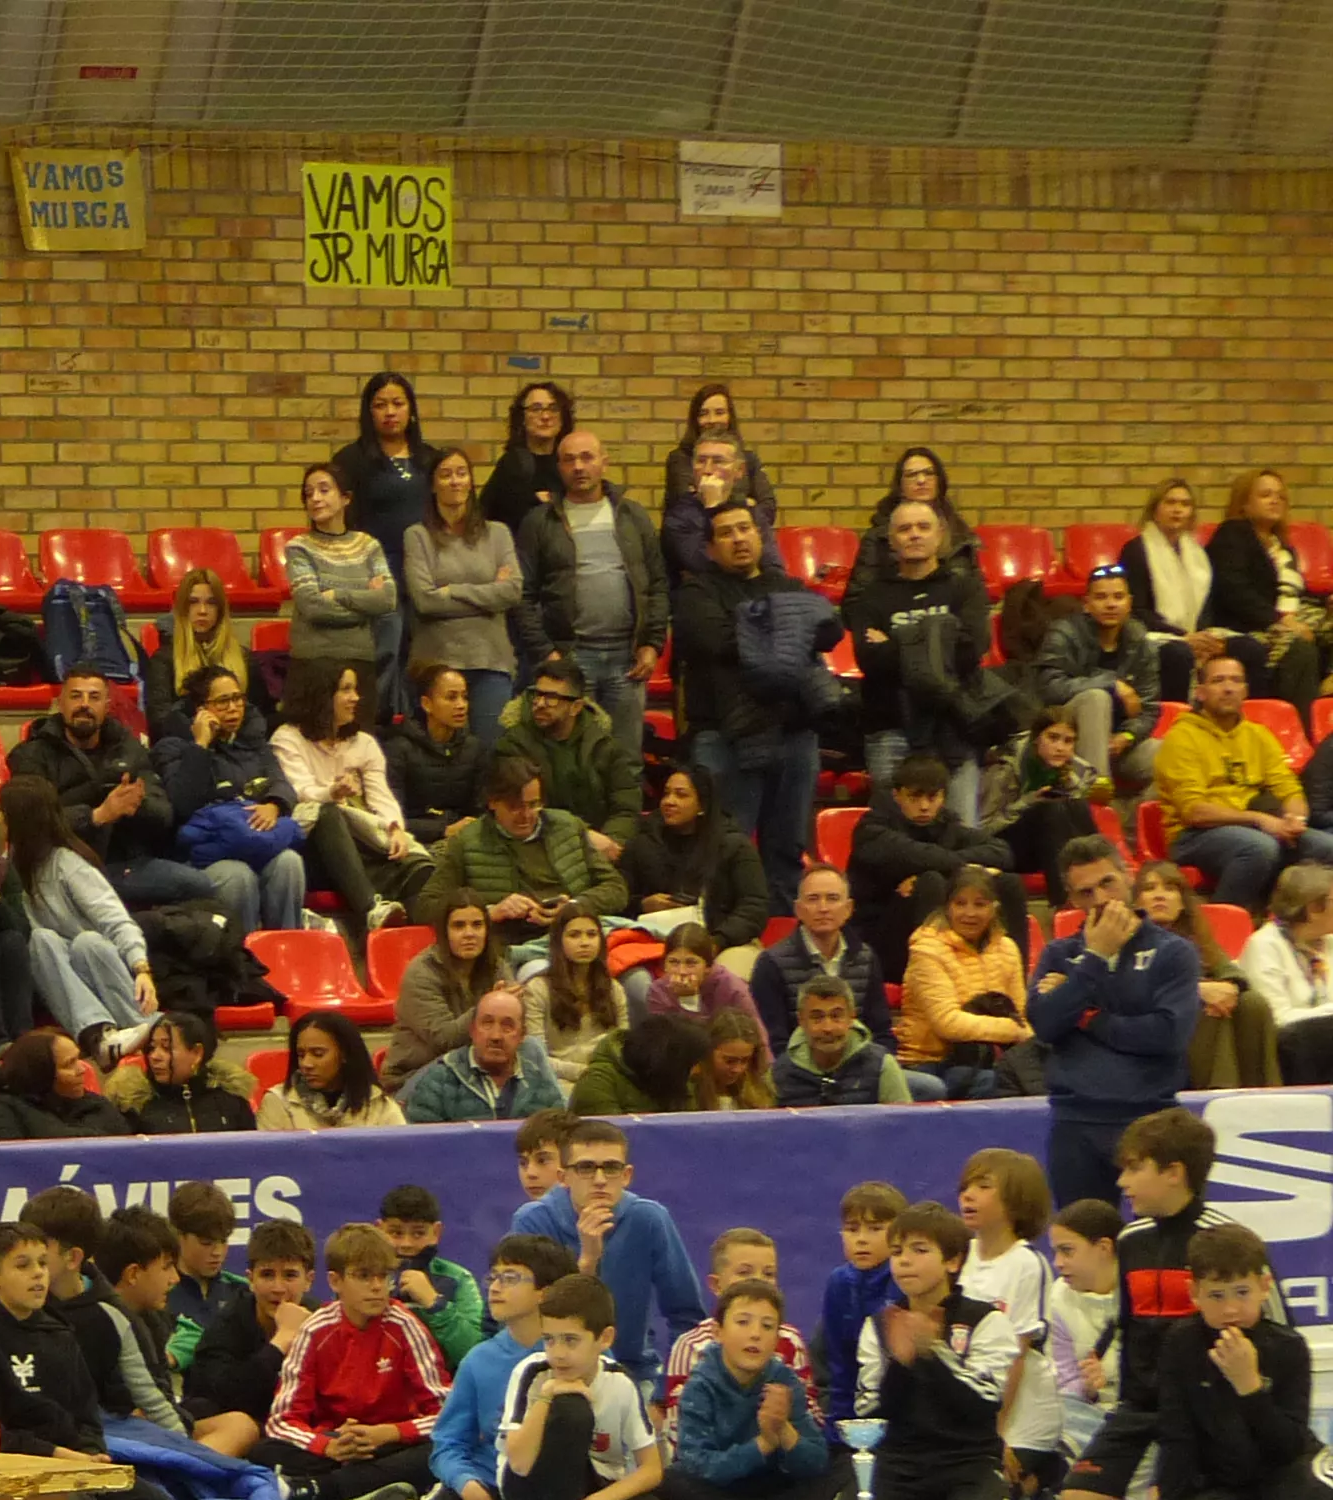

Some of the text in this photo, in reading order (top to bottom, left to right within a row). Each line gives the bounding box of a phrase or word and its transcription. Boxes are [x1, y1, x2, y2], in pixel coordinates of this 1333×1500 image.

[25, 161, 124, 193] VAMOS
[30, 201, 130, 229] MURGA
[307, 172, 446, 232] VAMOS
[309, 232, 451, 287] JR. MURGA
